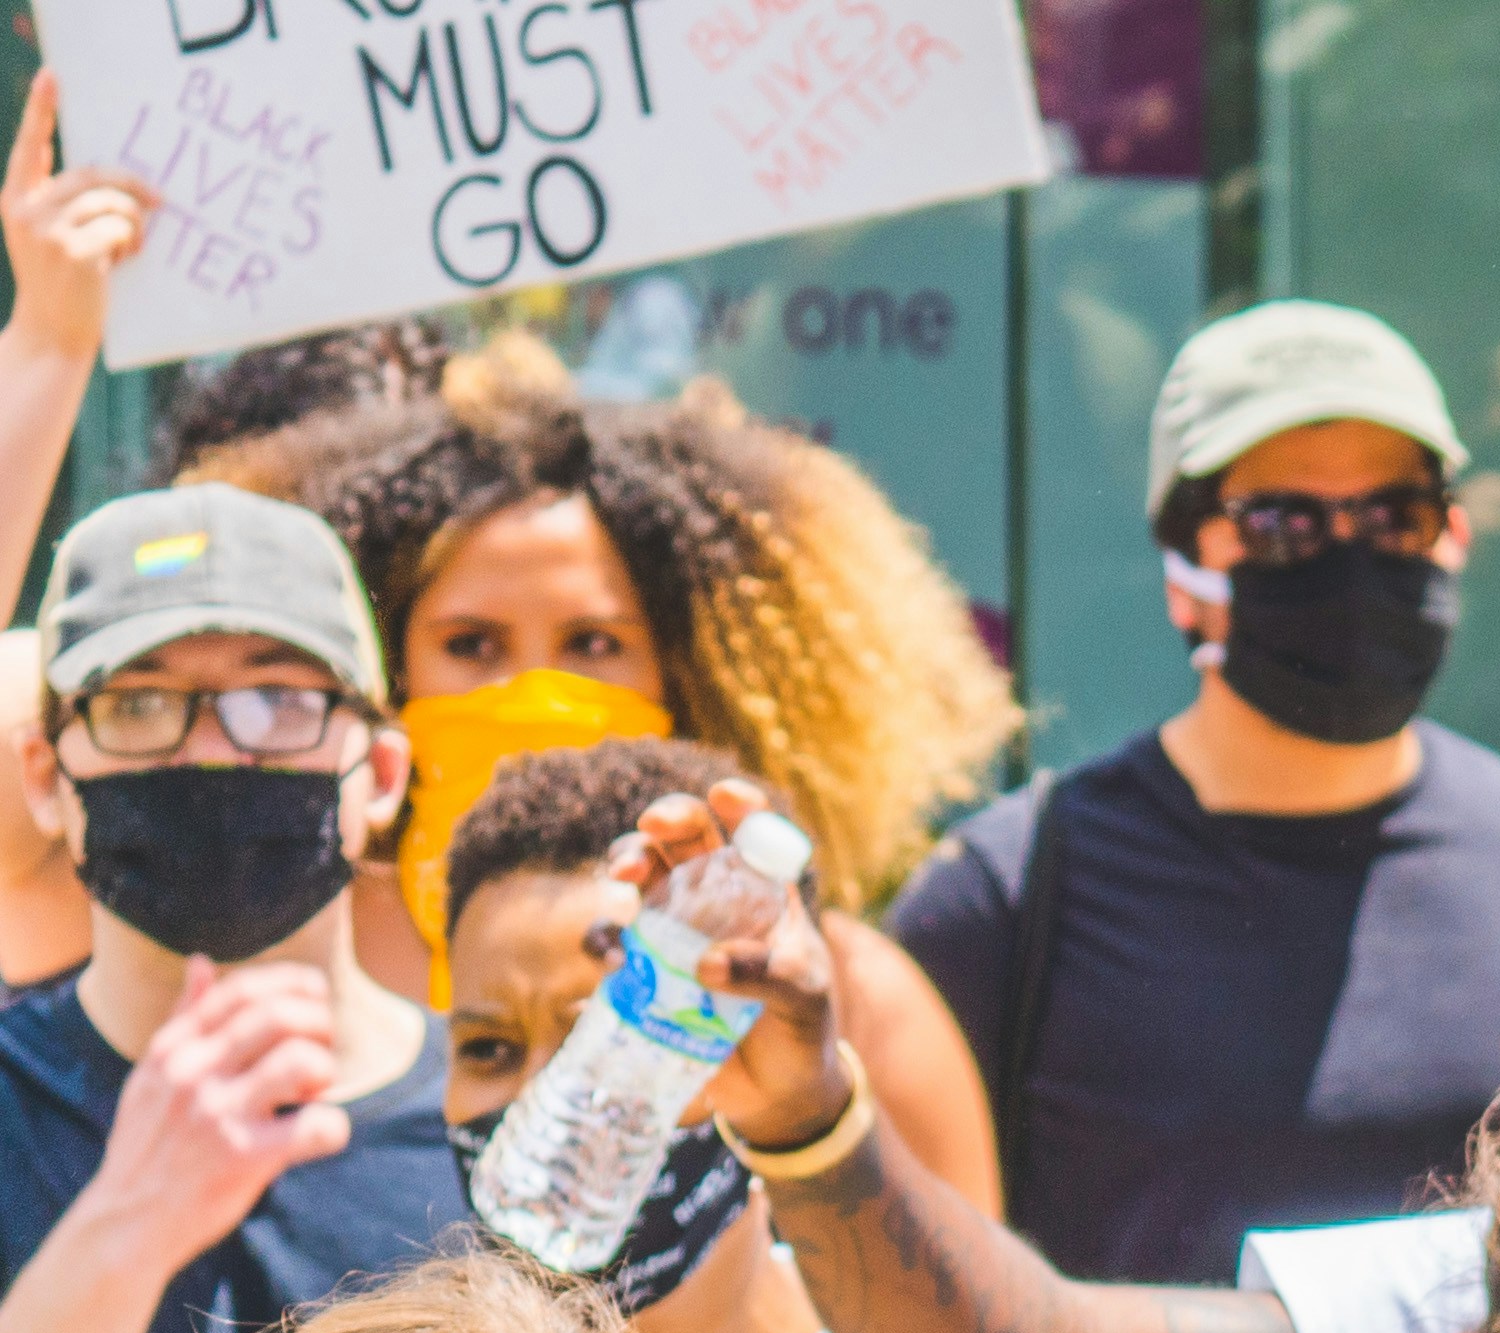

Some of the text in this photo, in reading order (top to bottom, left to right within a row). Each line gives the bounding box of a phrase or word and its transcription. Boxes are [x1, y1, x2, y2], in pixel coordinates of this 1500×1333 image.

[356, 0, 655, 172] MUST
[118, 102, 324, 257] LIVES
[432, 154, 607, 288] GO
[142, 198, 280, 314] TTER
[783, 285, 957, 362] one
